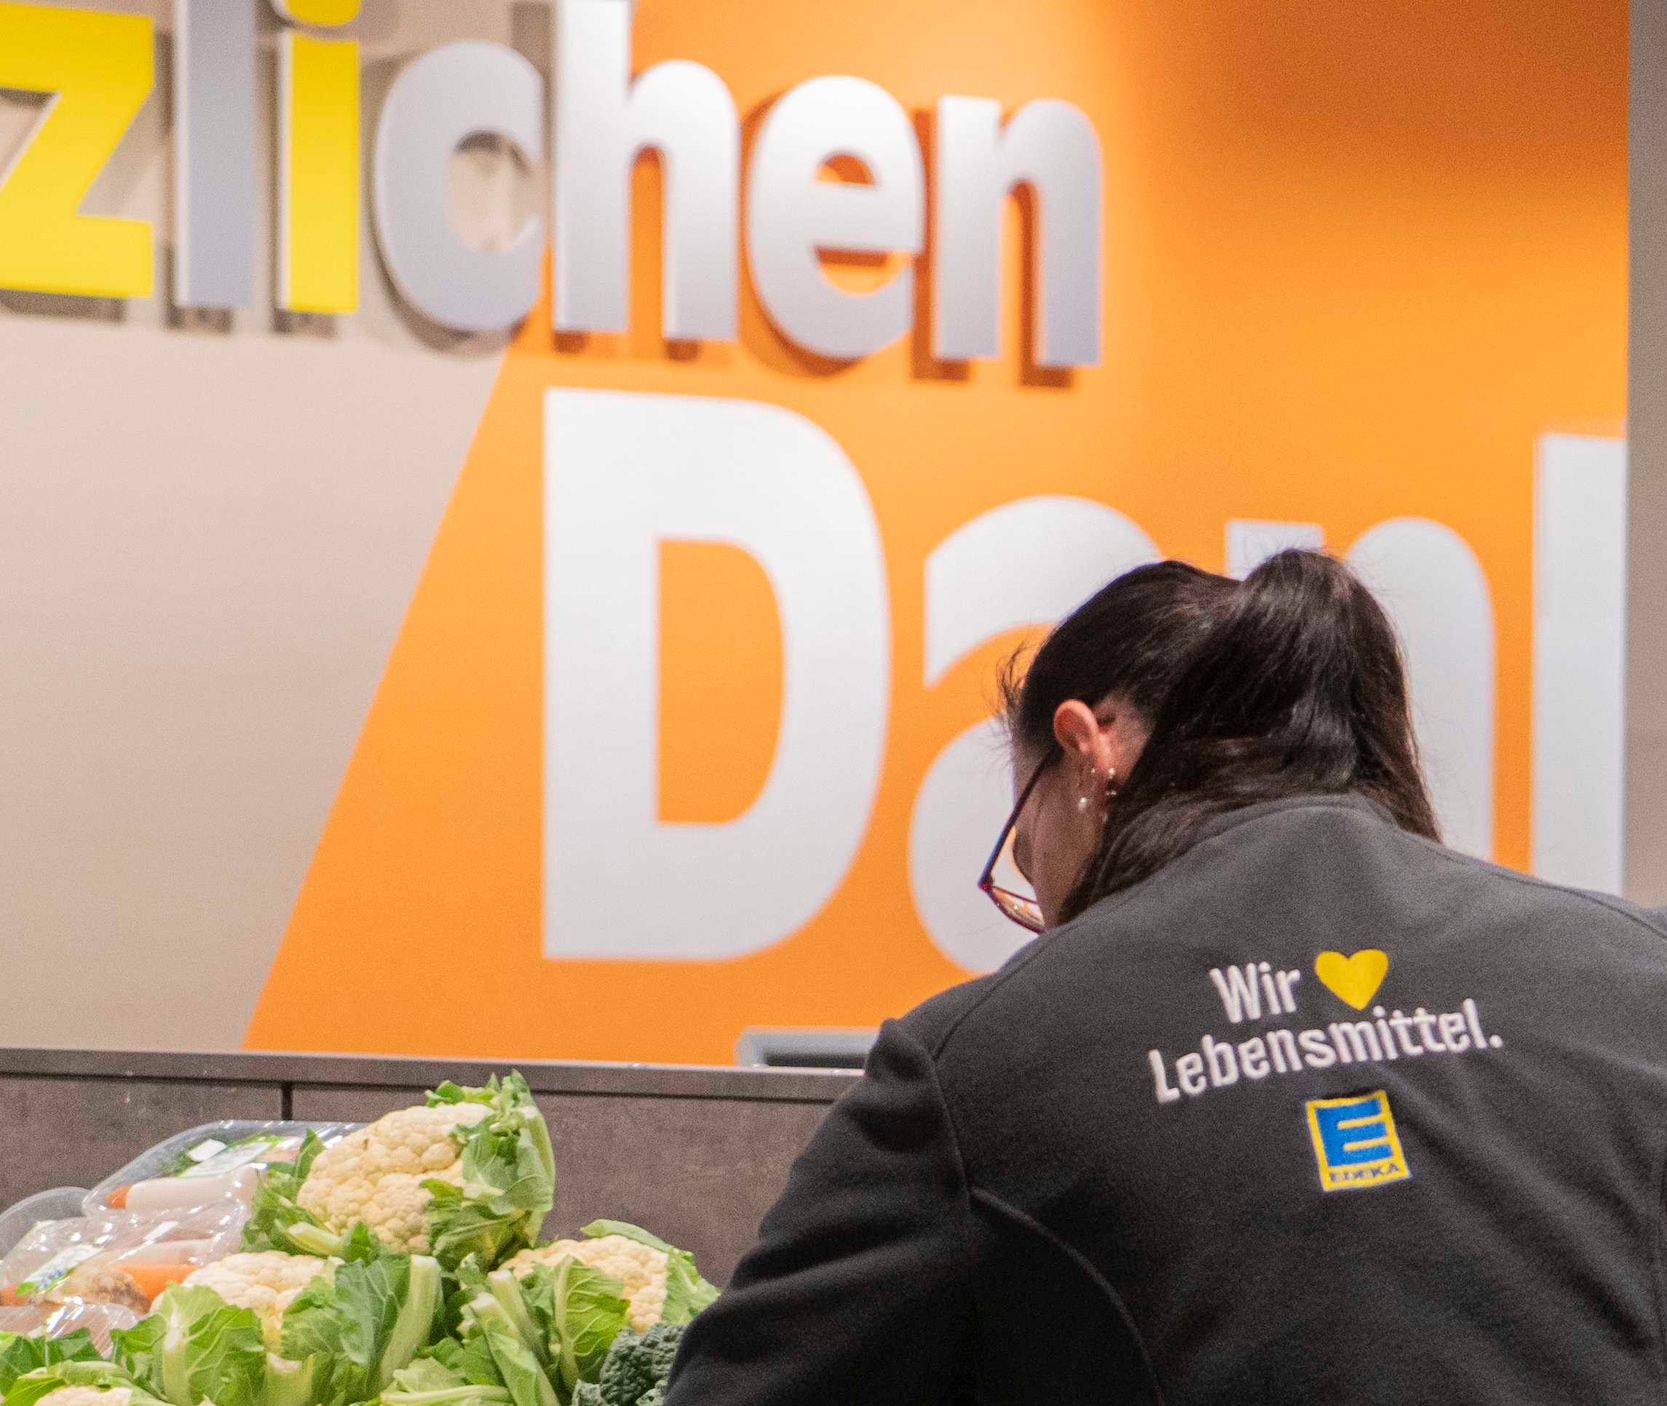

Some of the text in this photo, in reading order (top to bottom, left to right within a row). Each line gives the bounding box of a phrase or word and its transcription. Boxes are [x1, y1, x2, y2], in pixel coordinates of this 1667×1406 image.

[544, 386, 1628, 977] Dan
[1209, 961, 1301, 1024] Wir
[1148, 997, 1504, 1103] Lebensmittel.
[1329, 1162, 1400, 1182] EDEKA
